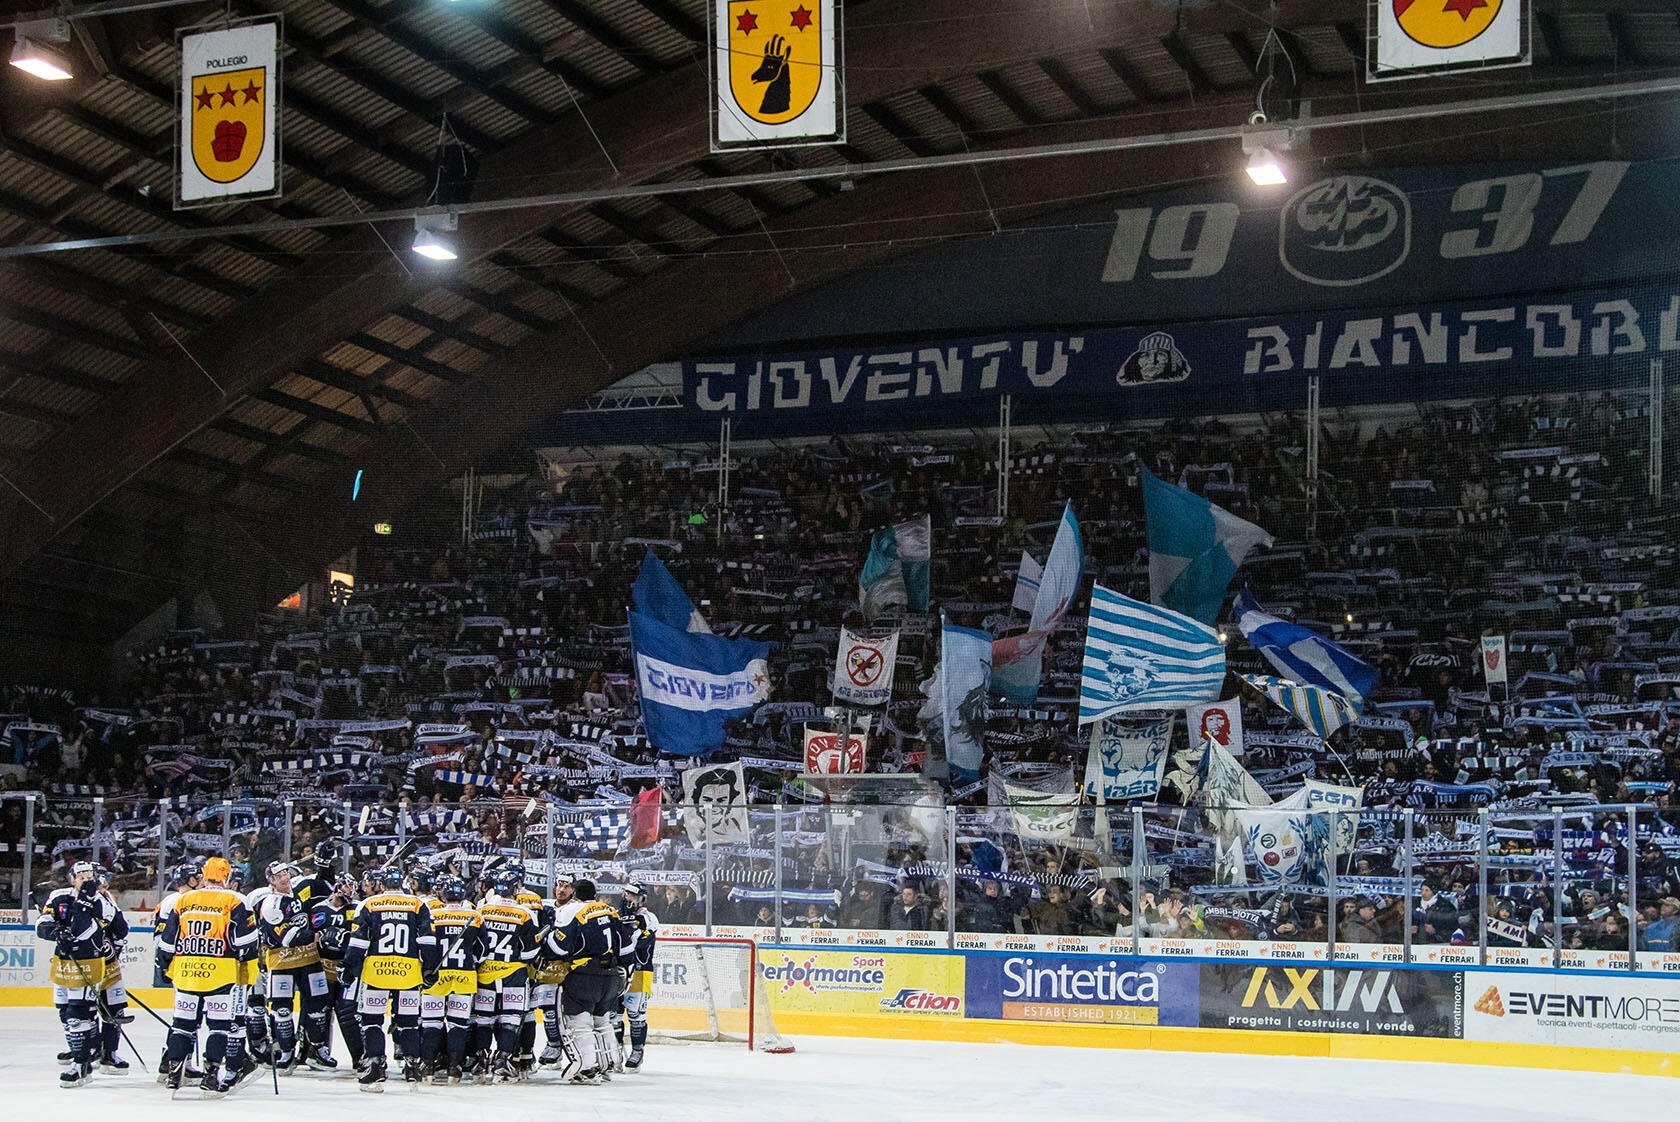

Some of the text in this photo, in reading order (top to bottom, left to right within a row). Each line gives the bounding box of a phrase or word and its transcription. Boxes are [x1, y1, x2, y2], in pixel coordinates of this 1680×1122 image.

[206, 55, 248, 69] POLLEGIO
[1101, 161, 1632, 283] 19 37
[1102, 719, 1170, 740] ULTRAS
[330, 914, 344, 926] 79
[381, 911, 408, 921] BIANCHI
[187, 920, 212, 936] TOP
[378, 923, 410, 954] 20
[602, 927, 613, 954] 1
[811, 937, 839, 945] FERRARI
[857, 938, 886, 946] FERRARI
[175, 937, 224, 955] SCORER
[906, 939, 936, 947] FERRARI
[956, 941, 987, 949] FERRARI
[1005, 943, 1035, 951] FERRARI
[1161, 940, 1185, 948] ENNIO
[1216, 941, 1241, 949] ENNIO
[440, 938, 466, 968] 14
[1110, 946, 1141, 954] FERRAI
[1216, 949, 1248, 957] FERRARI
[1440, 947, 1466, 955] ENNIO
[1496, 949, 1520, 957] ENNIO
[1326, 952, 1359, 960] FRRARI
[1440, 955, 1474, 963] FERRARI
[373, 961, 412, 969] CHICCO
[852, 956, 885, 968] Sport
[1496, 957, 1529, 965] FERRARI
[1609, 961, 1642, 969] FERRRI
[180, 962, 217, 971] CHICCO
[181, 970, 211, 978] DORO
[376, 968, 407, 977] DORO
[368, 997, 387, 1005] BDO
[425, 1001, 444, 1009] BDO
[1452, 971, 1462, 1038] eventmore.ch
[450, 1001, 468, 1010] BDO
[1509, 991, 1680, 1022] EVENTMORE
[1024, 1007, 1137, 1020] ESTABLISHED 1921
[1228, 1016, 1415, 1032] progetta costruisce vende
[1537, 1018, 1566, 1027] tecnica
